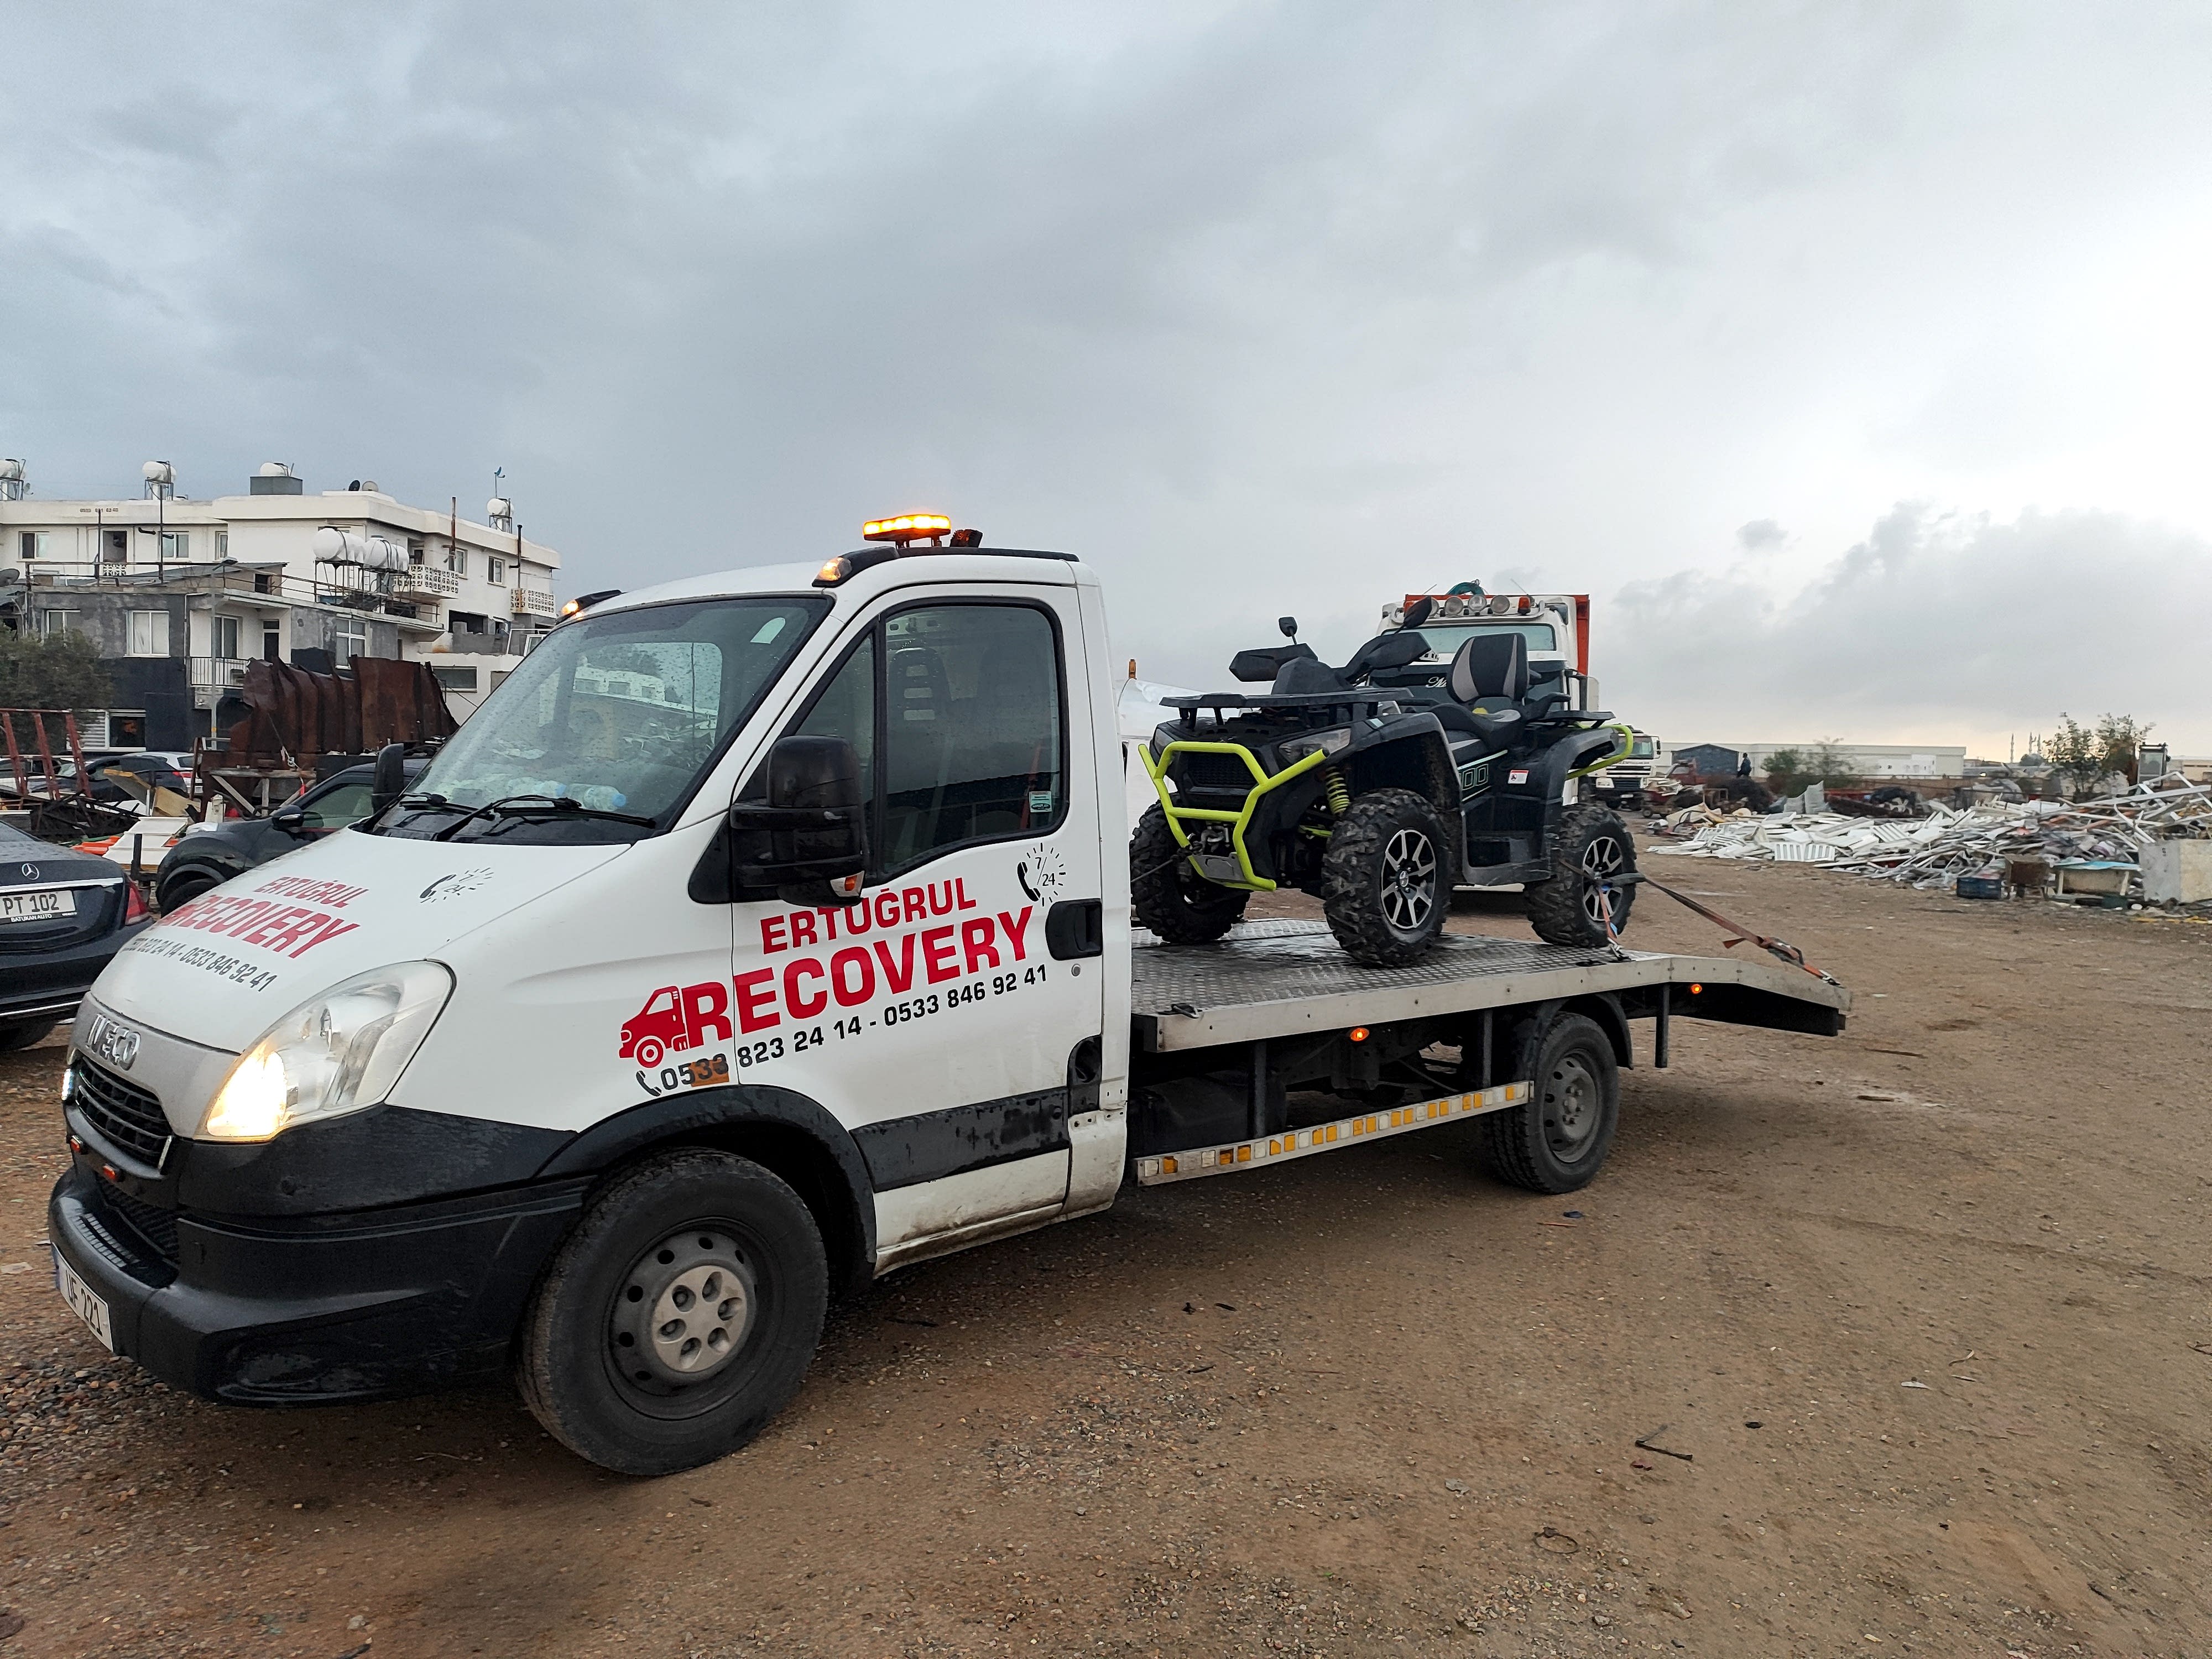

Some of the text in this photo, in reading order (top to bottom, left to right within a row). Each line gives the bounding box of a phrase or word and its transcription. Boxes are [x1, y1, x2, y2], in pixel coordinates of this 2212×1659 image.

[3, 894, 59, 915] PT 102
[160, 894, 361, 959] RECOVERY
[760, 877, 977, 954] ERTUĞRUL
[179, 947, 217, 967] 0533
[206, 955, 239, 975] 846
[229, 963, 258, 983] 92
[249, 972, 277, 992] 41
[681, 905, 1033, 1049] RECOVERY
[85, 1013, 140, 1071] IVECO
[660, 1053, 729, 1091] 0533
[737, 1037, 784, 1068] 823
[794, 1026, 825, 1052] 24
[833, 1016, 862, 1040] 14
[884, 994, 939, 1026] 0533
[947, 982, 985, 1008] 846
[993, 973, 1017, 995] 92
[1024, 964, 1047, 985] 41
[66, 1270, 102, 1337] UF 221
